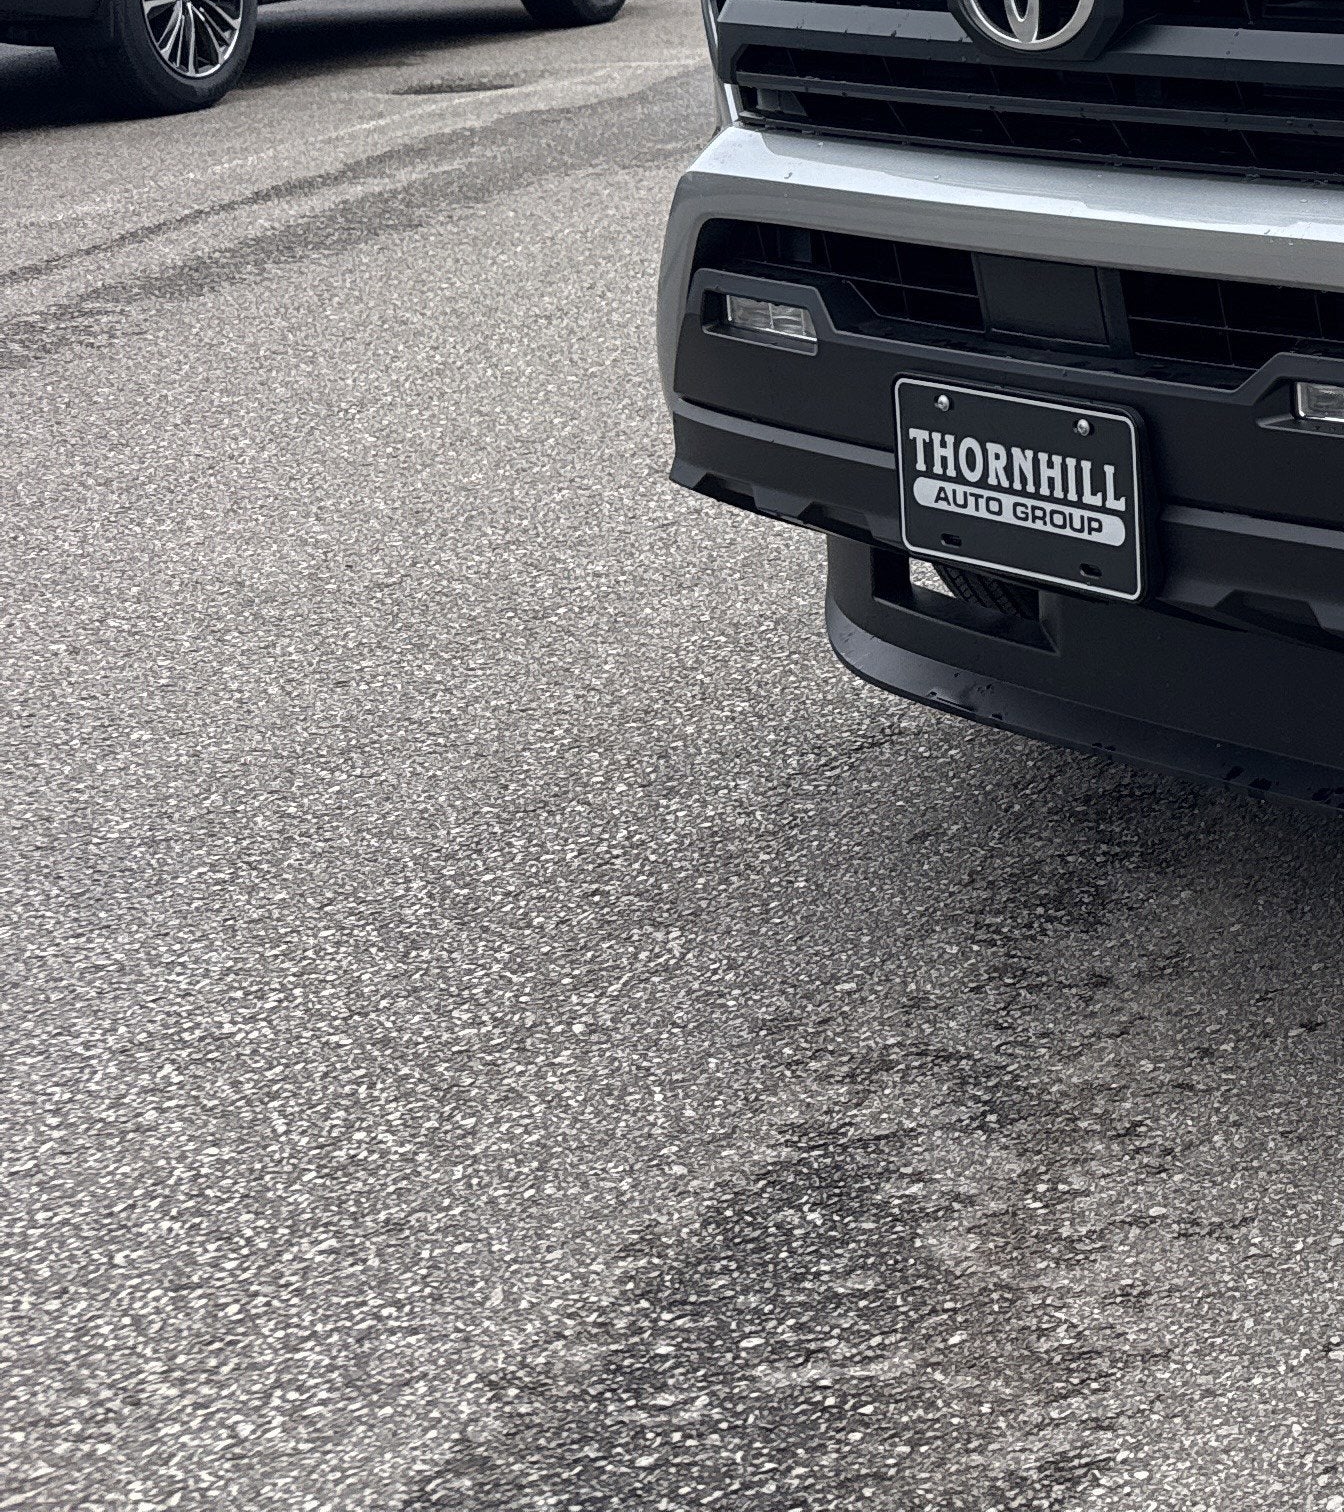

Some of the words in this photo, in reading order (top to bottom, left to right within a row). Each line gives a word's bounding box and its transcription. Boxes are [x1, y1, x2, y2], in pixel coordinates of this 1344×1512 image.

[908, 427, 1126, 511] THORNHILL
[934, 486, 1003, 516] AUTO
[1012, 501, 1103, 536] GROUP
